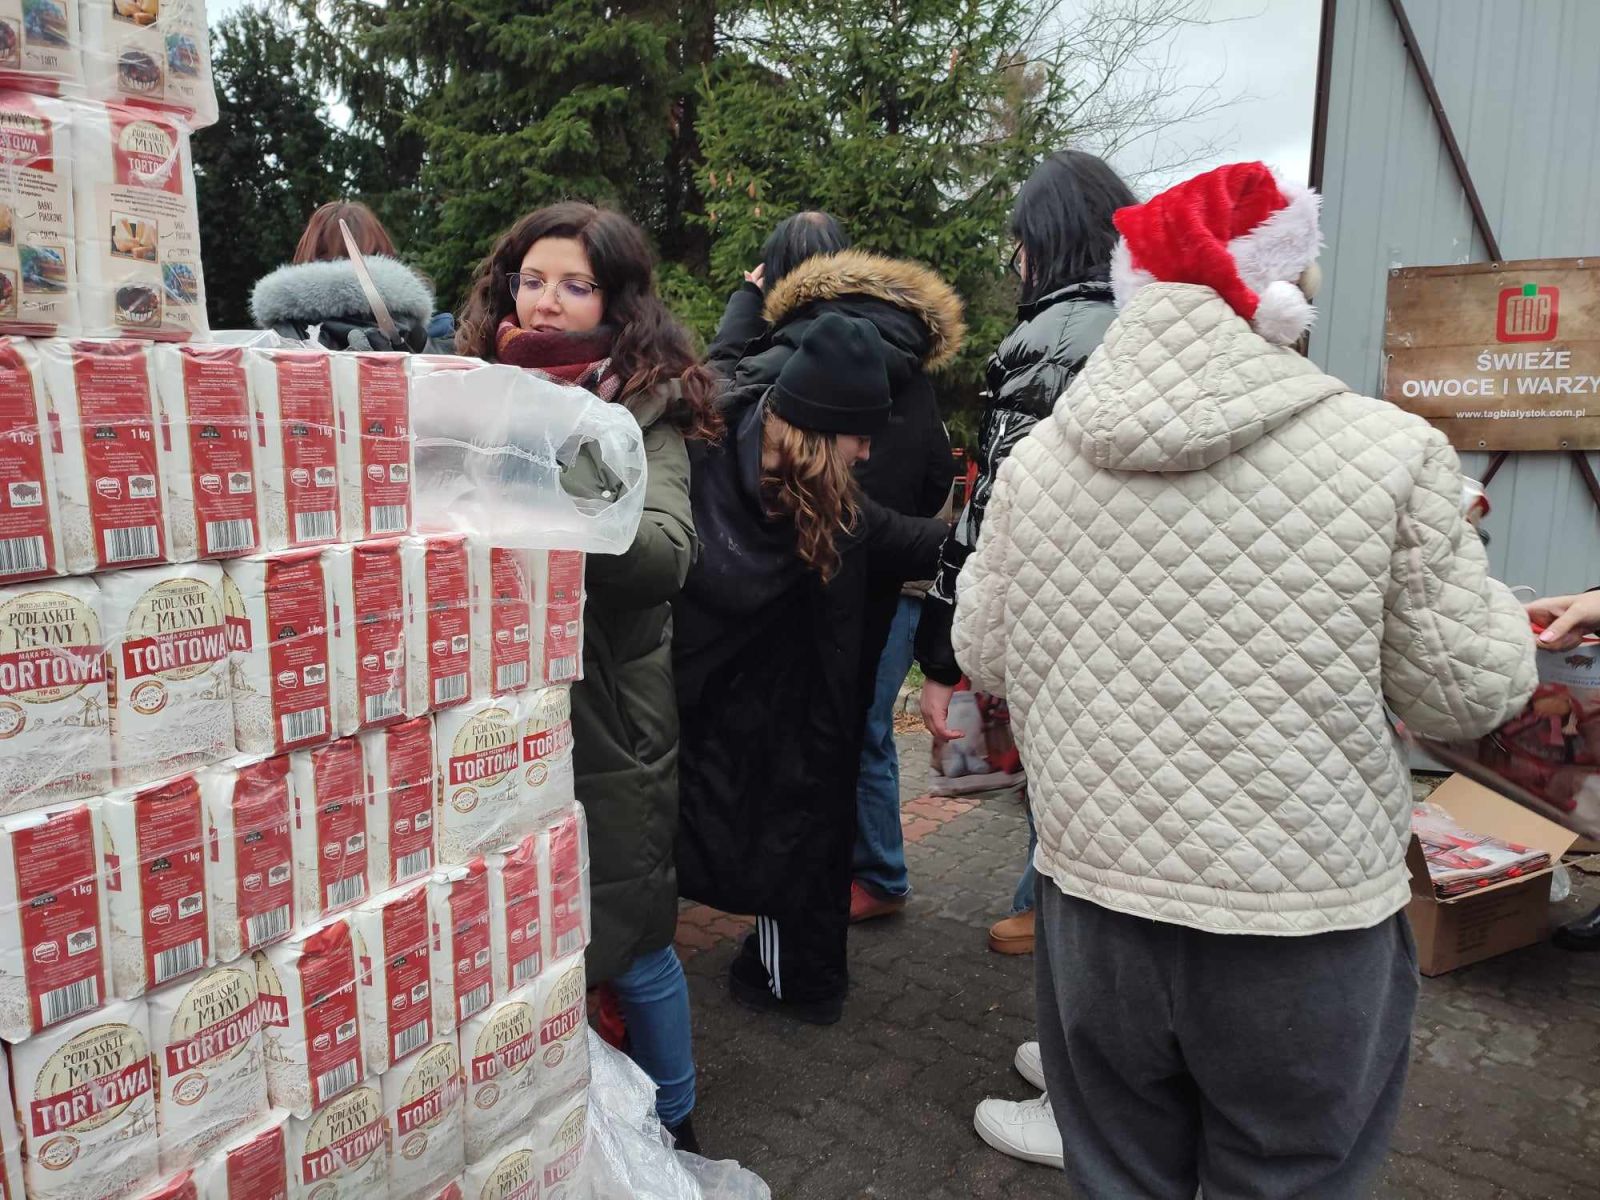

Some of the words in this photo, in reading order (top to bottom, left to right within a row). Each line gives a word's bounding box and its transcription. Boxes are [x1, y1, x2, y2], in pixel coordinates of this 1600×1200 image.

[1476, 347, 1571, 372] ŚWIEŻE
[1402, 378, 1495, 397] OWOCE
[1456, 408, 1586, 420] www.tagbialystok.com.pl
[139, 428, 150, 441] kg
[238, 429, 247, 441] kg
[8, 607, 77, 627] PODLASKIE
[128, 632, 227, 673] TORTOWA
[0, 653, 103, 690] ORTOWA
[453, 747, 518, 781] TORTOWA
[190, 851, 200, 863] kg
[80, 882, 92, 895] kg
[172, 1008, 262, 1070] TORTOWA
[63, 1034, 124, 1068] PODLASKIE
[36, 1067, 149, 1131] TORTOWA
